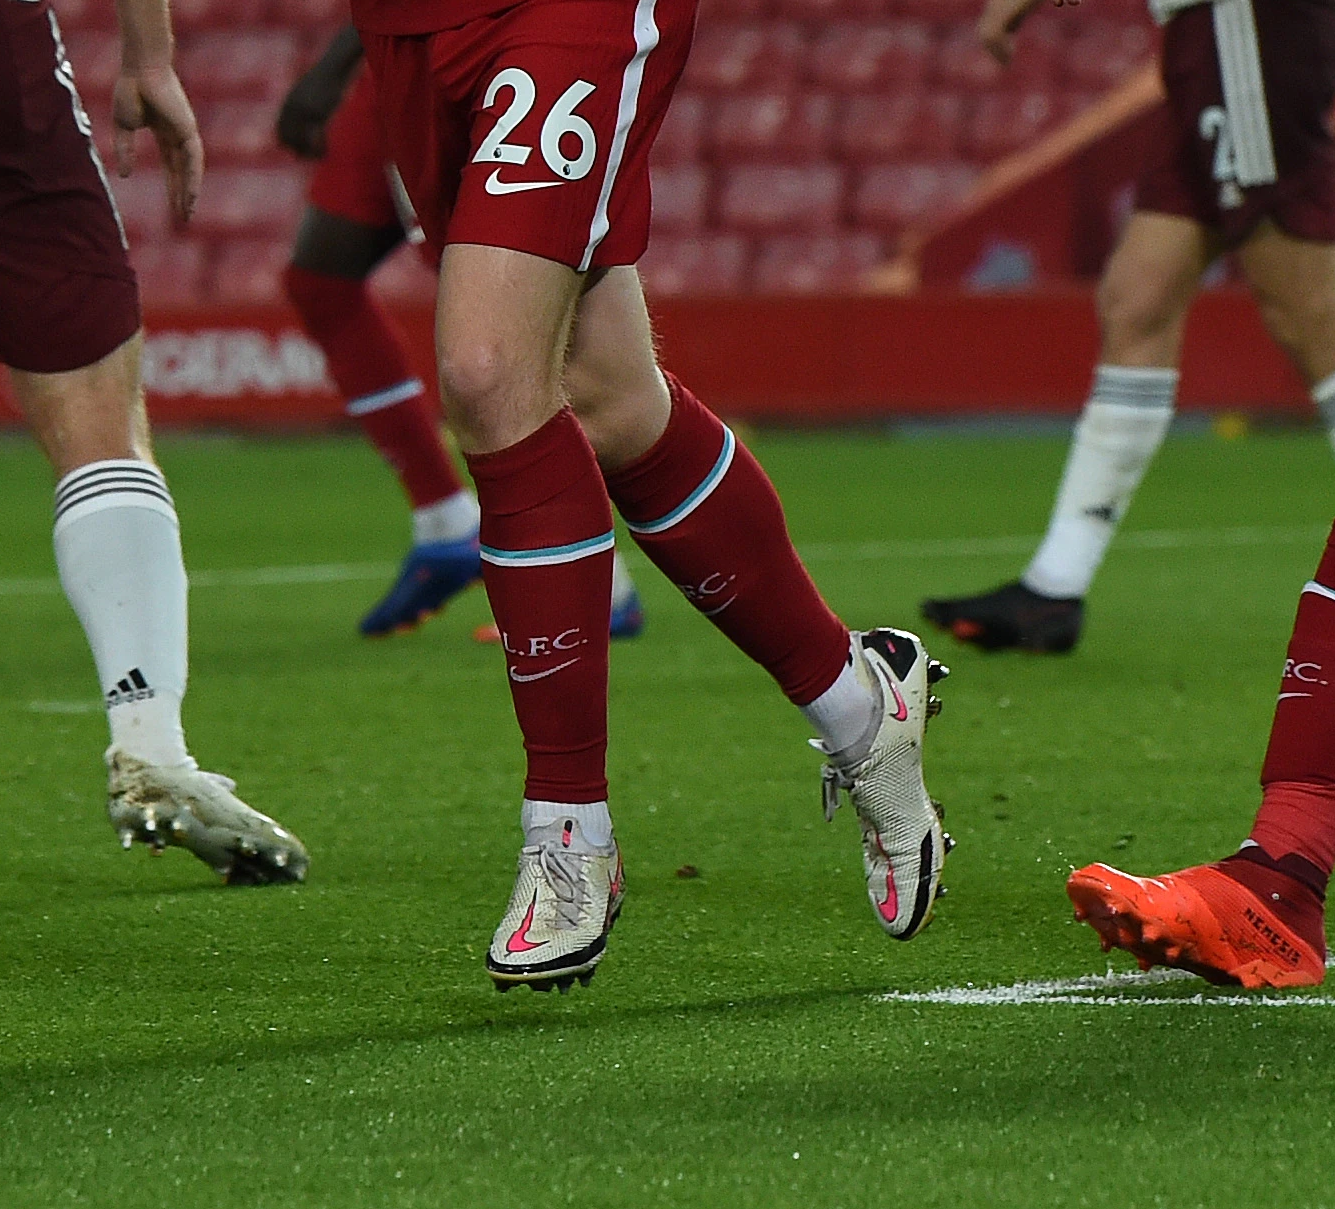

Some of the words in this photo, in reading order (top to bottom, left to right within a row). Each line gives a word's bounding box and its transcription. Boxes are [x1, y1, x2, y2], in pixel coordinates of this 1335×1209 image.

[471, 67, 597, 180] 26
[502, 628, 589, 658] L.F.C.
[1245, 906, 1302, 968] NEMESIS
